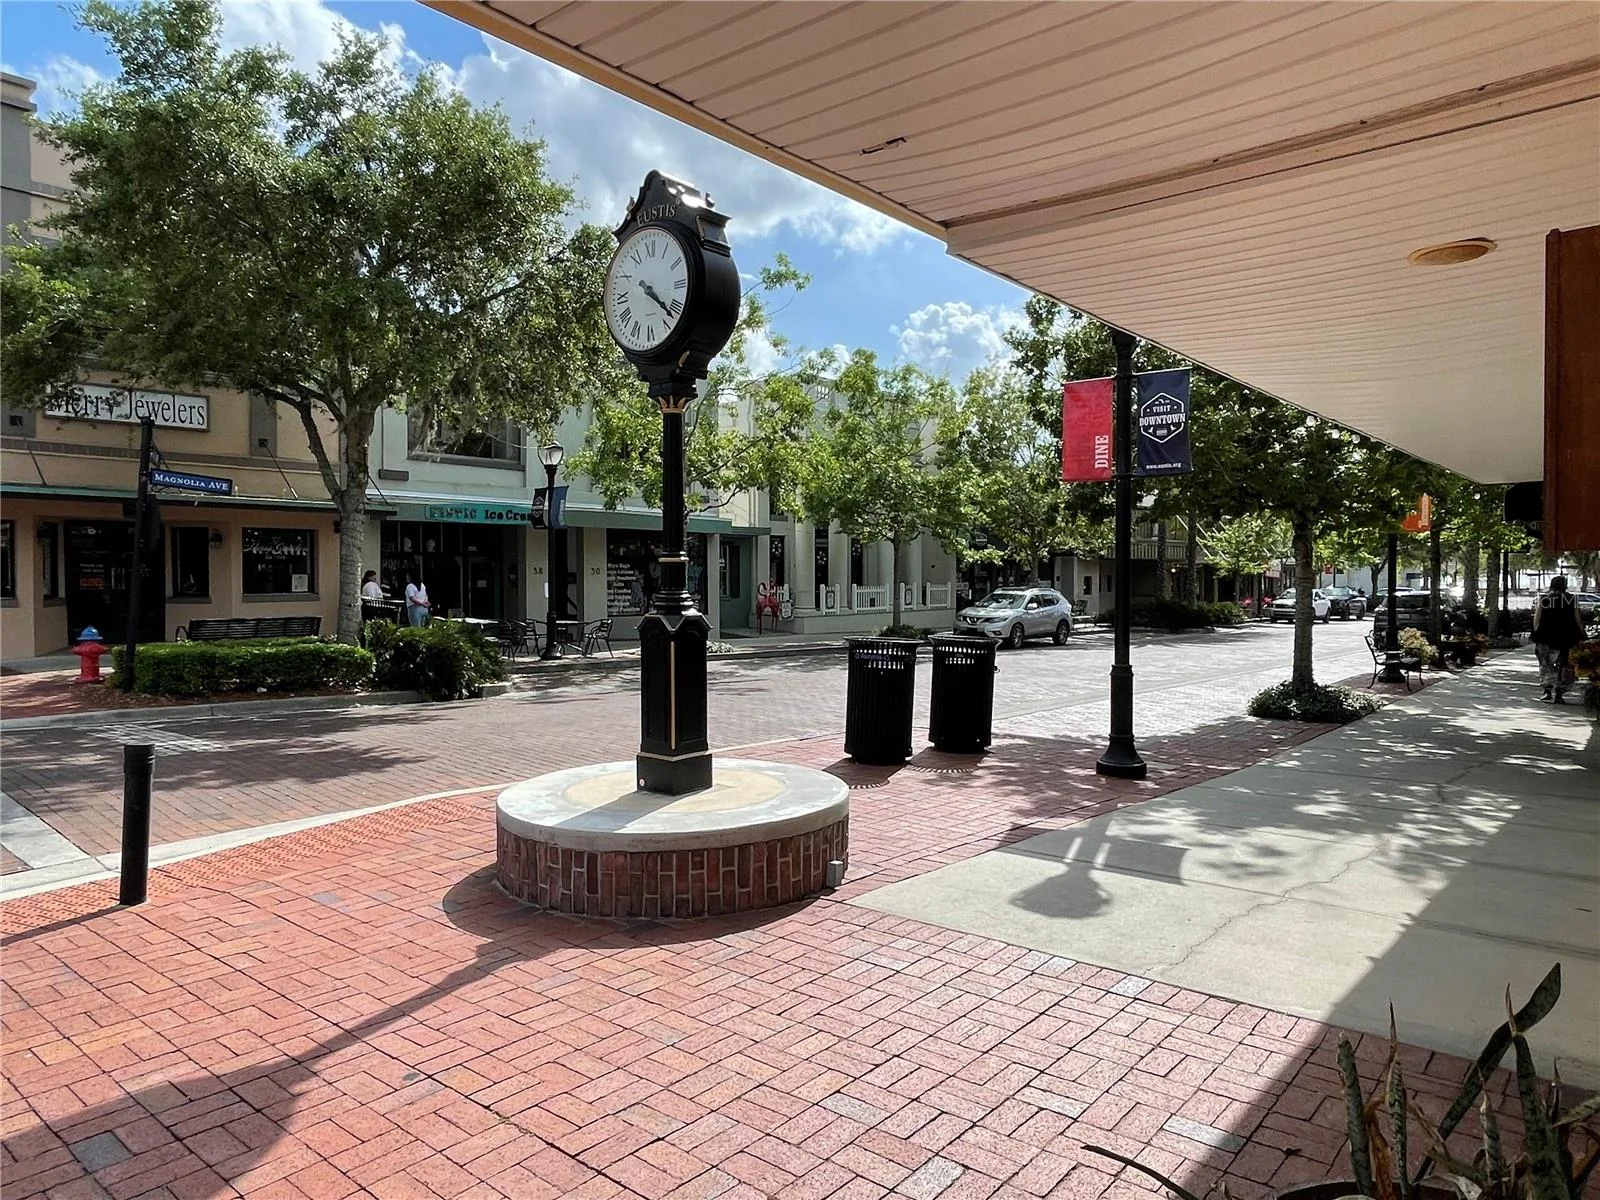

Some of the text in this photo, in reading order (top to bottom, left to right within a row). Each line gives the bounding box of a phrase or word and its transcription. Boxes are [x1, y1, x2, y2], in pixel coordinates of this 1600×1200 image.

[637, 203, 676, 227] EUSTIS
[645, 240, 656, 259] XII
[671, 256, 682, 271] II
[674, 279, 686, 289] III
[617, 292, 628, 305] IX
[126, 390, 205, 426] Jewelers
[1153, 404, 1171, 413] VISIT
[1139, 413, 1186, 426] DOWNTOWN
[1095, 435, 1108, 469] DINE
[208, 481, 228, 491] AVE
[484, 510, 503, 520] Ice
[506, 510, 532, 521] Crea
[533, 567, 543, 575] 38
[591, 567, 600, 575] 30
